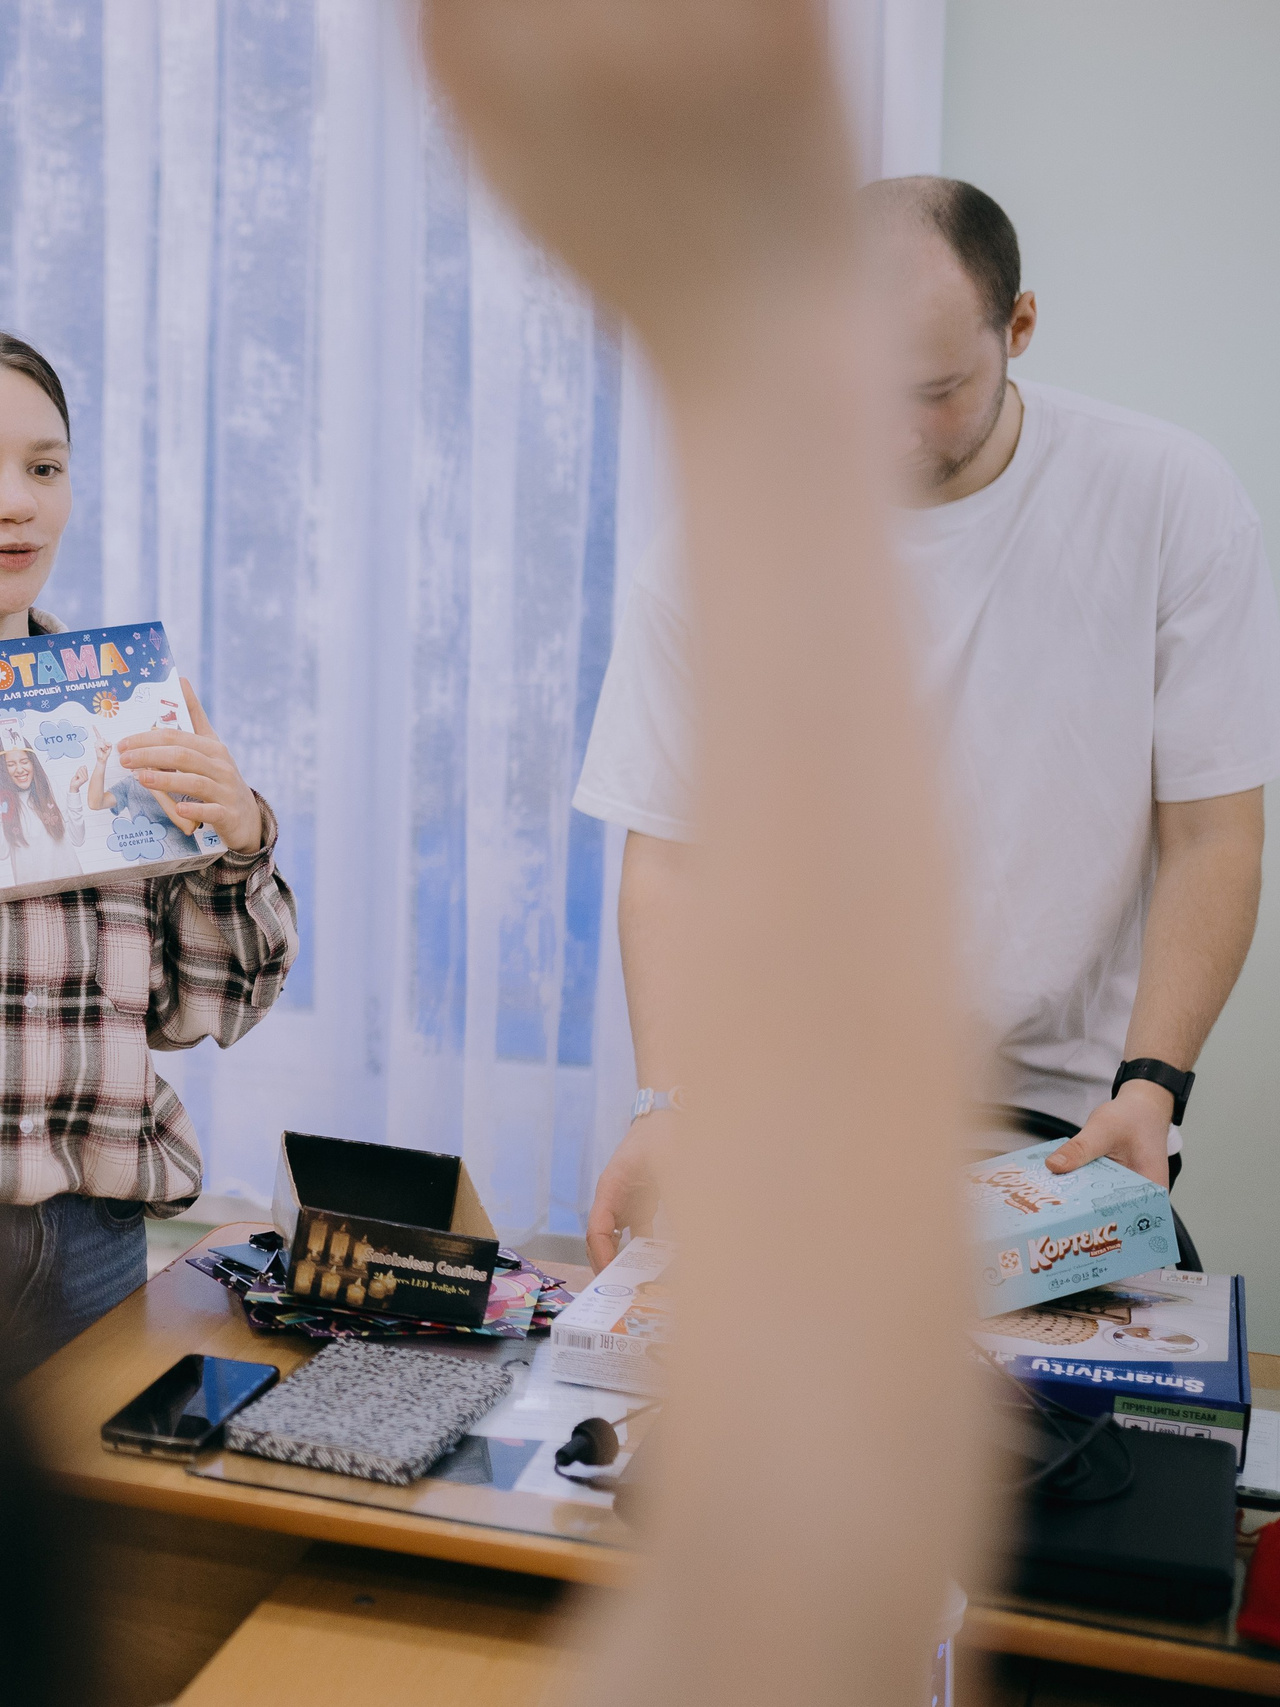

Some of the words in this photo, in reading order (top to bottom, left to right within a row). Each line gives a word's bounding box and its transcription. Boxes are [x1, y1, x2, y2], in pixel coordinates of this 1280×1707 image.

[3, 691, 22, 702] ДЛЯ
[23, 686, 62, 698] ХОРОШЕЙ
[66, 680, 109, 692] КОМПАНИИ
[44, 735, 63, 745] КТО
[66, 733, 77, 742] Я?
[116, 829, 144, 841] УГАДАЙ
[144, 829, 153, 837] ЗА
[364, 1247, 435, 1273] Smokeless
[436, 1260, 488, 1282] Candles
[411, 1278, 429, 1289] LED
[458, 1285, 471, 1296] Set
[1031, 1358, 1205, 1393] Smartivity
[1121, 1401, 1180, 1418] ПРИНЦИПЫ
[1182, 1408, 1217, 1423] STEAM
